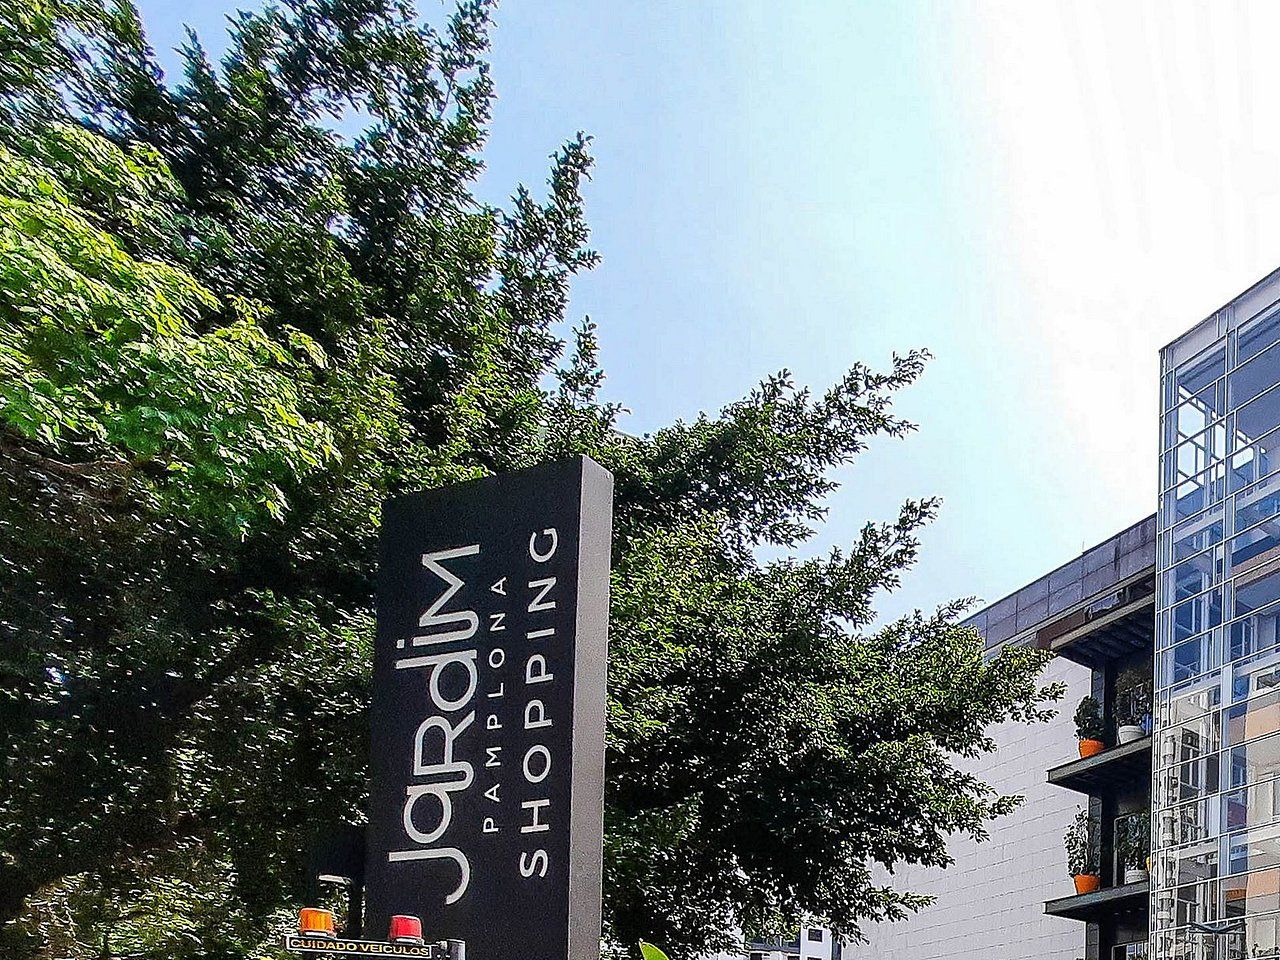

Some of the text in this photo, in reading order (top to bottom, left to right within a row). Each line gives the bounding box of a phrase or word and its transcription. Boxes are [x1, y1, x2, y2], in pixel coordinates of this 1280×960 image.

[483, 575, 508, 835] PAMPLONA
[519, 526, 560, 880] SHOPPING
[290, 938, 356, 951] CUIDADO
